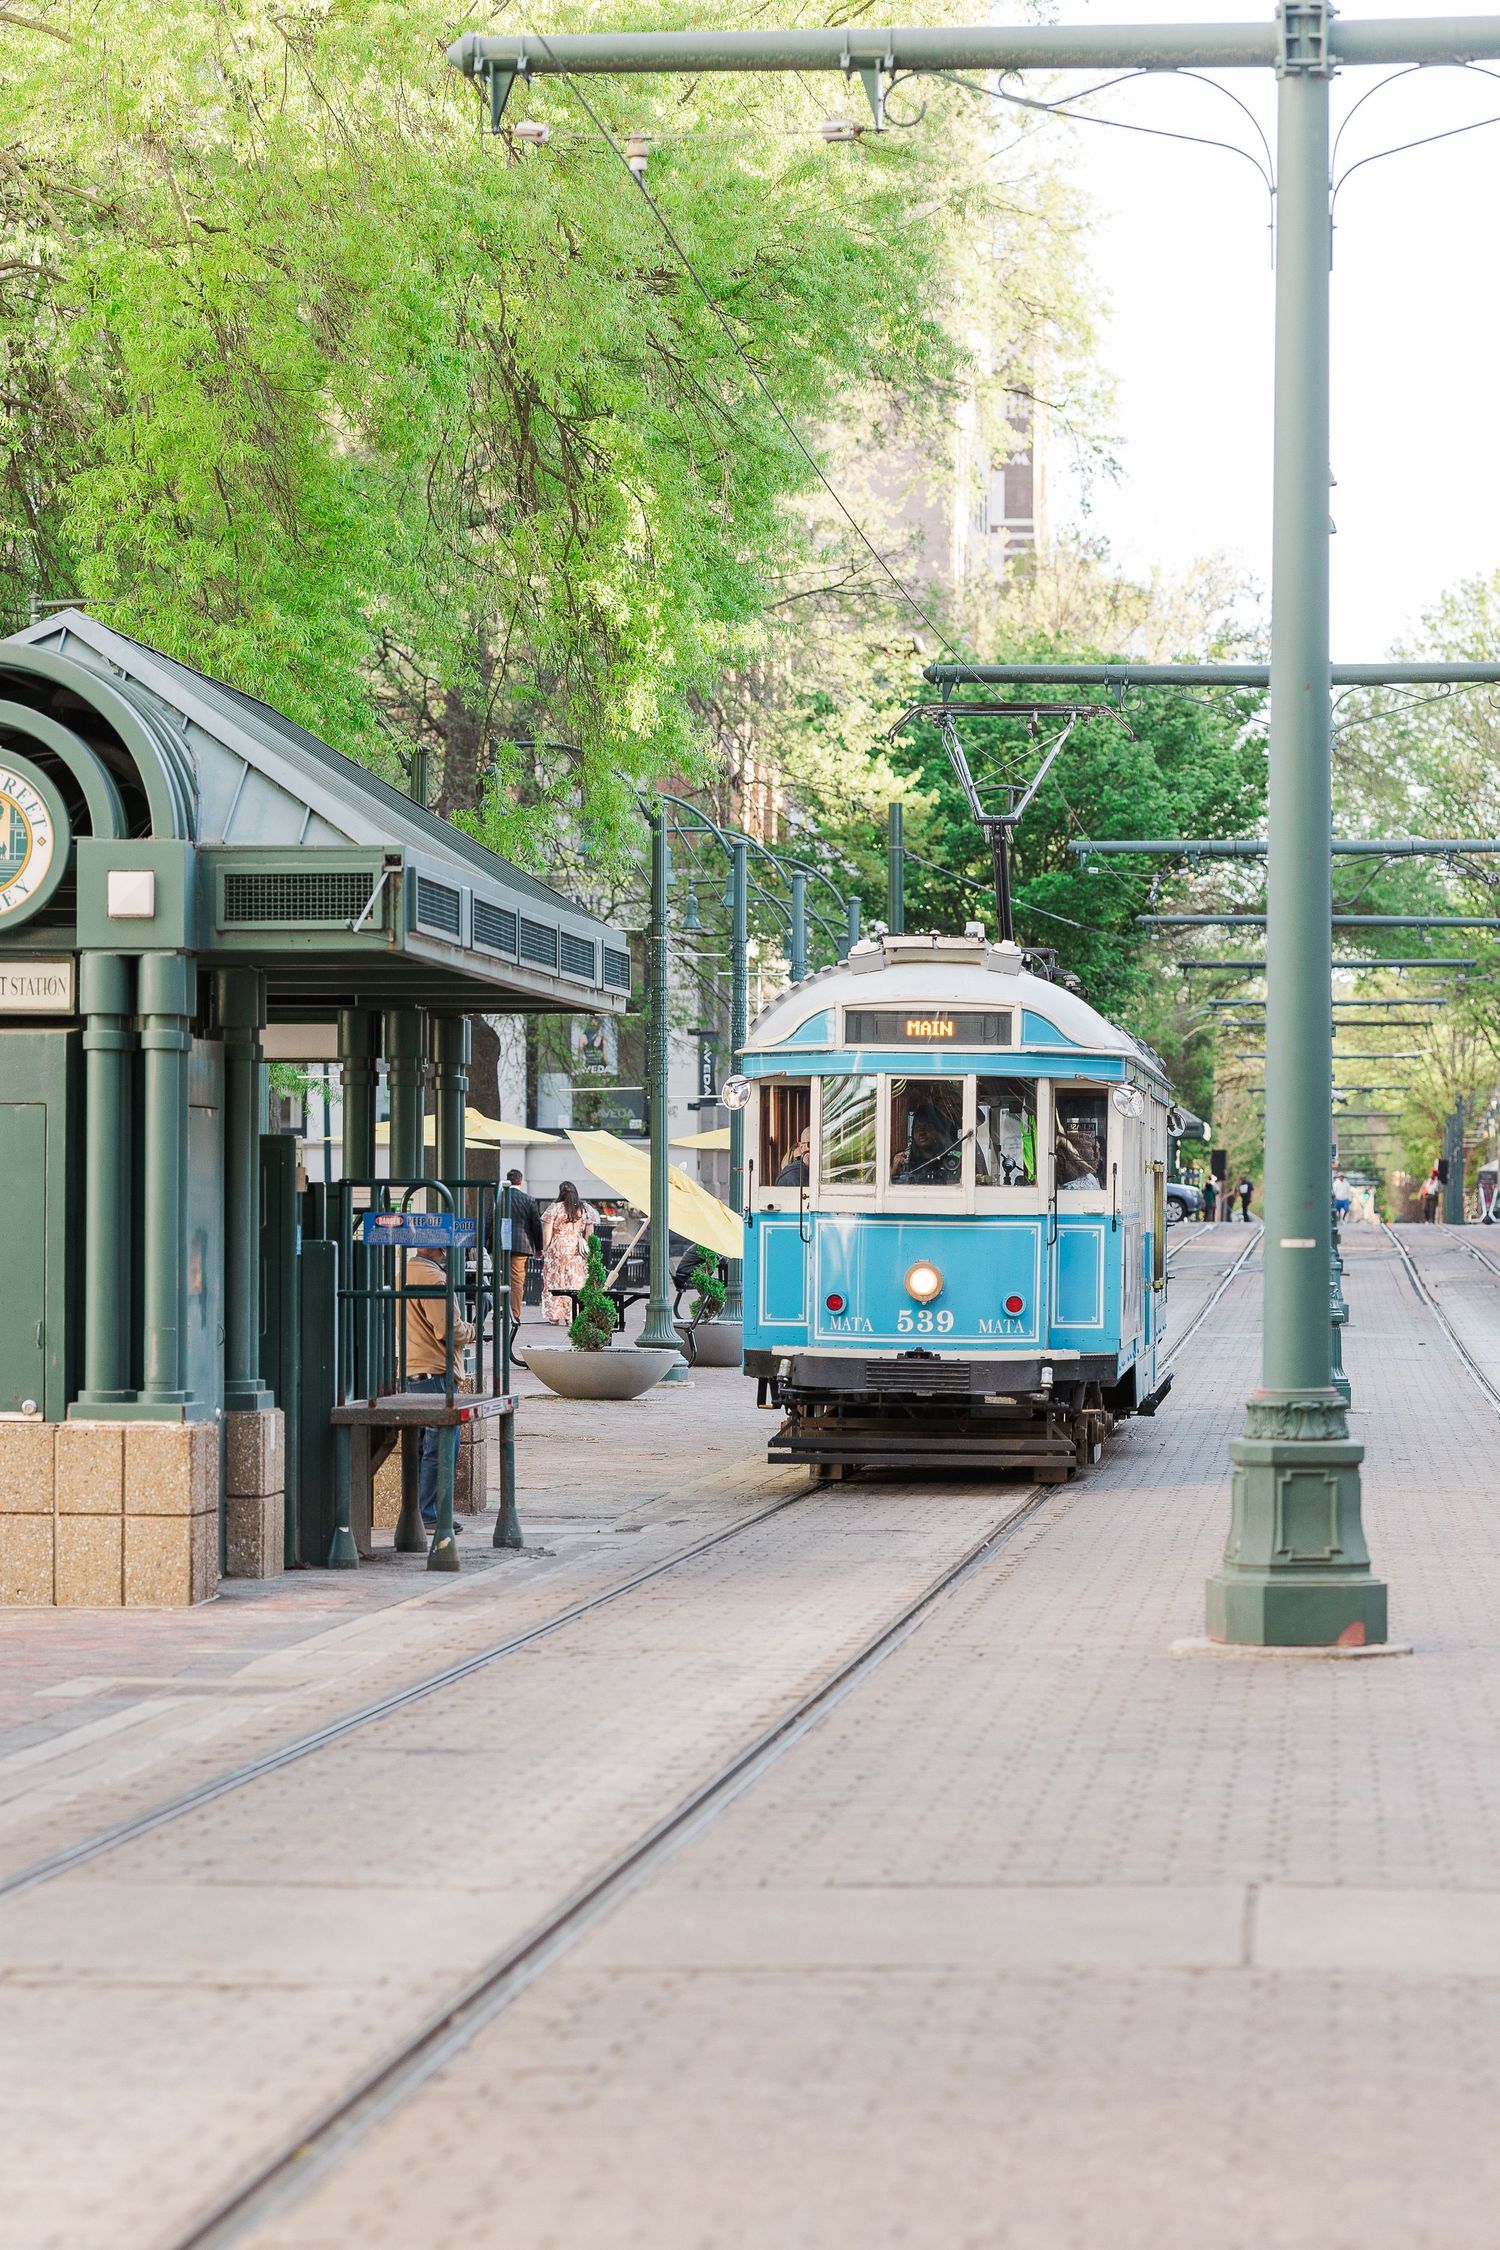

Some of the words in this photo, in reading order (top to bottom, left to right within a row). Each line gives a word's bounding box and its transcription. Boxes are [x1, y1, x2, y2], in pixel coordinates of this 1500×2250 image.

[0, 774, 48, 827] REET
[0, 878, 29, 911] EY
[10, 976, 67, 996] STATION
[906, 1020, 953, 1036] MAIN
[703, 1041, 712, 1096] AVEDA
[406, 1215, 426, 1226] KEEP
[428, 1216, 442, 1226] OFF
[460, 1222, 473, 1231] OFF
[829, 1315, 874, 1332] MATA
[896, 1309, 954, 1333] 539
[978, 1319, 1025, 1334] MATA
